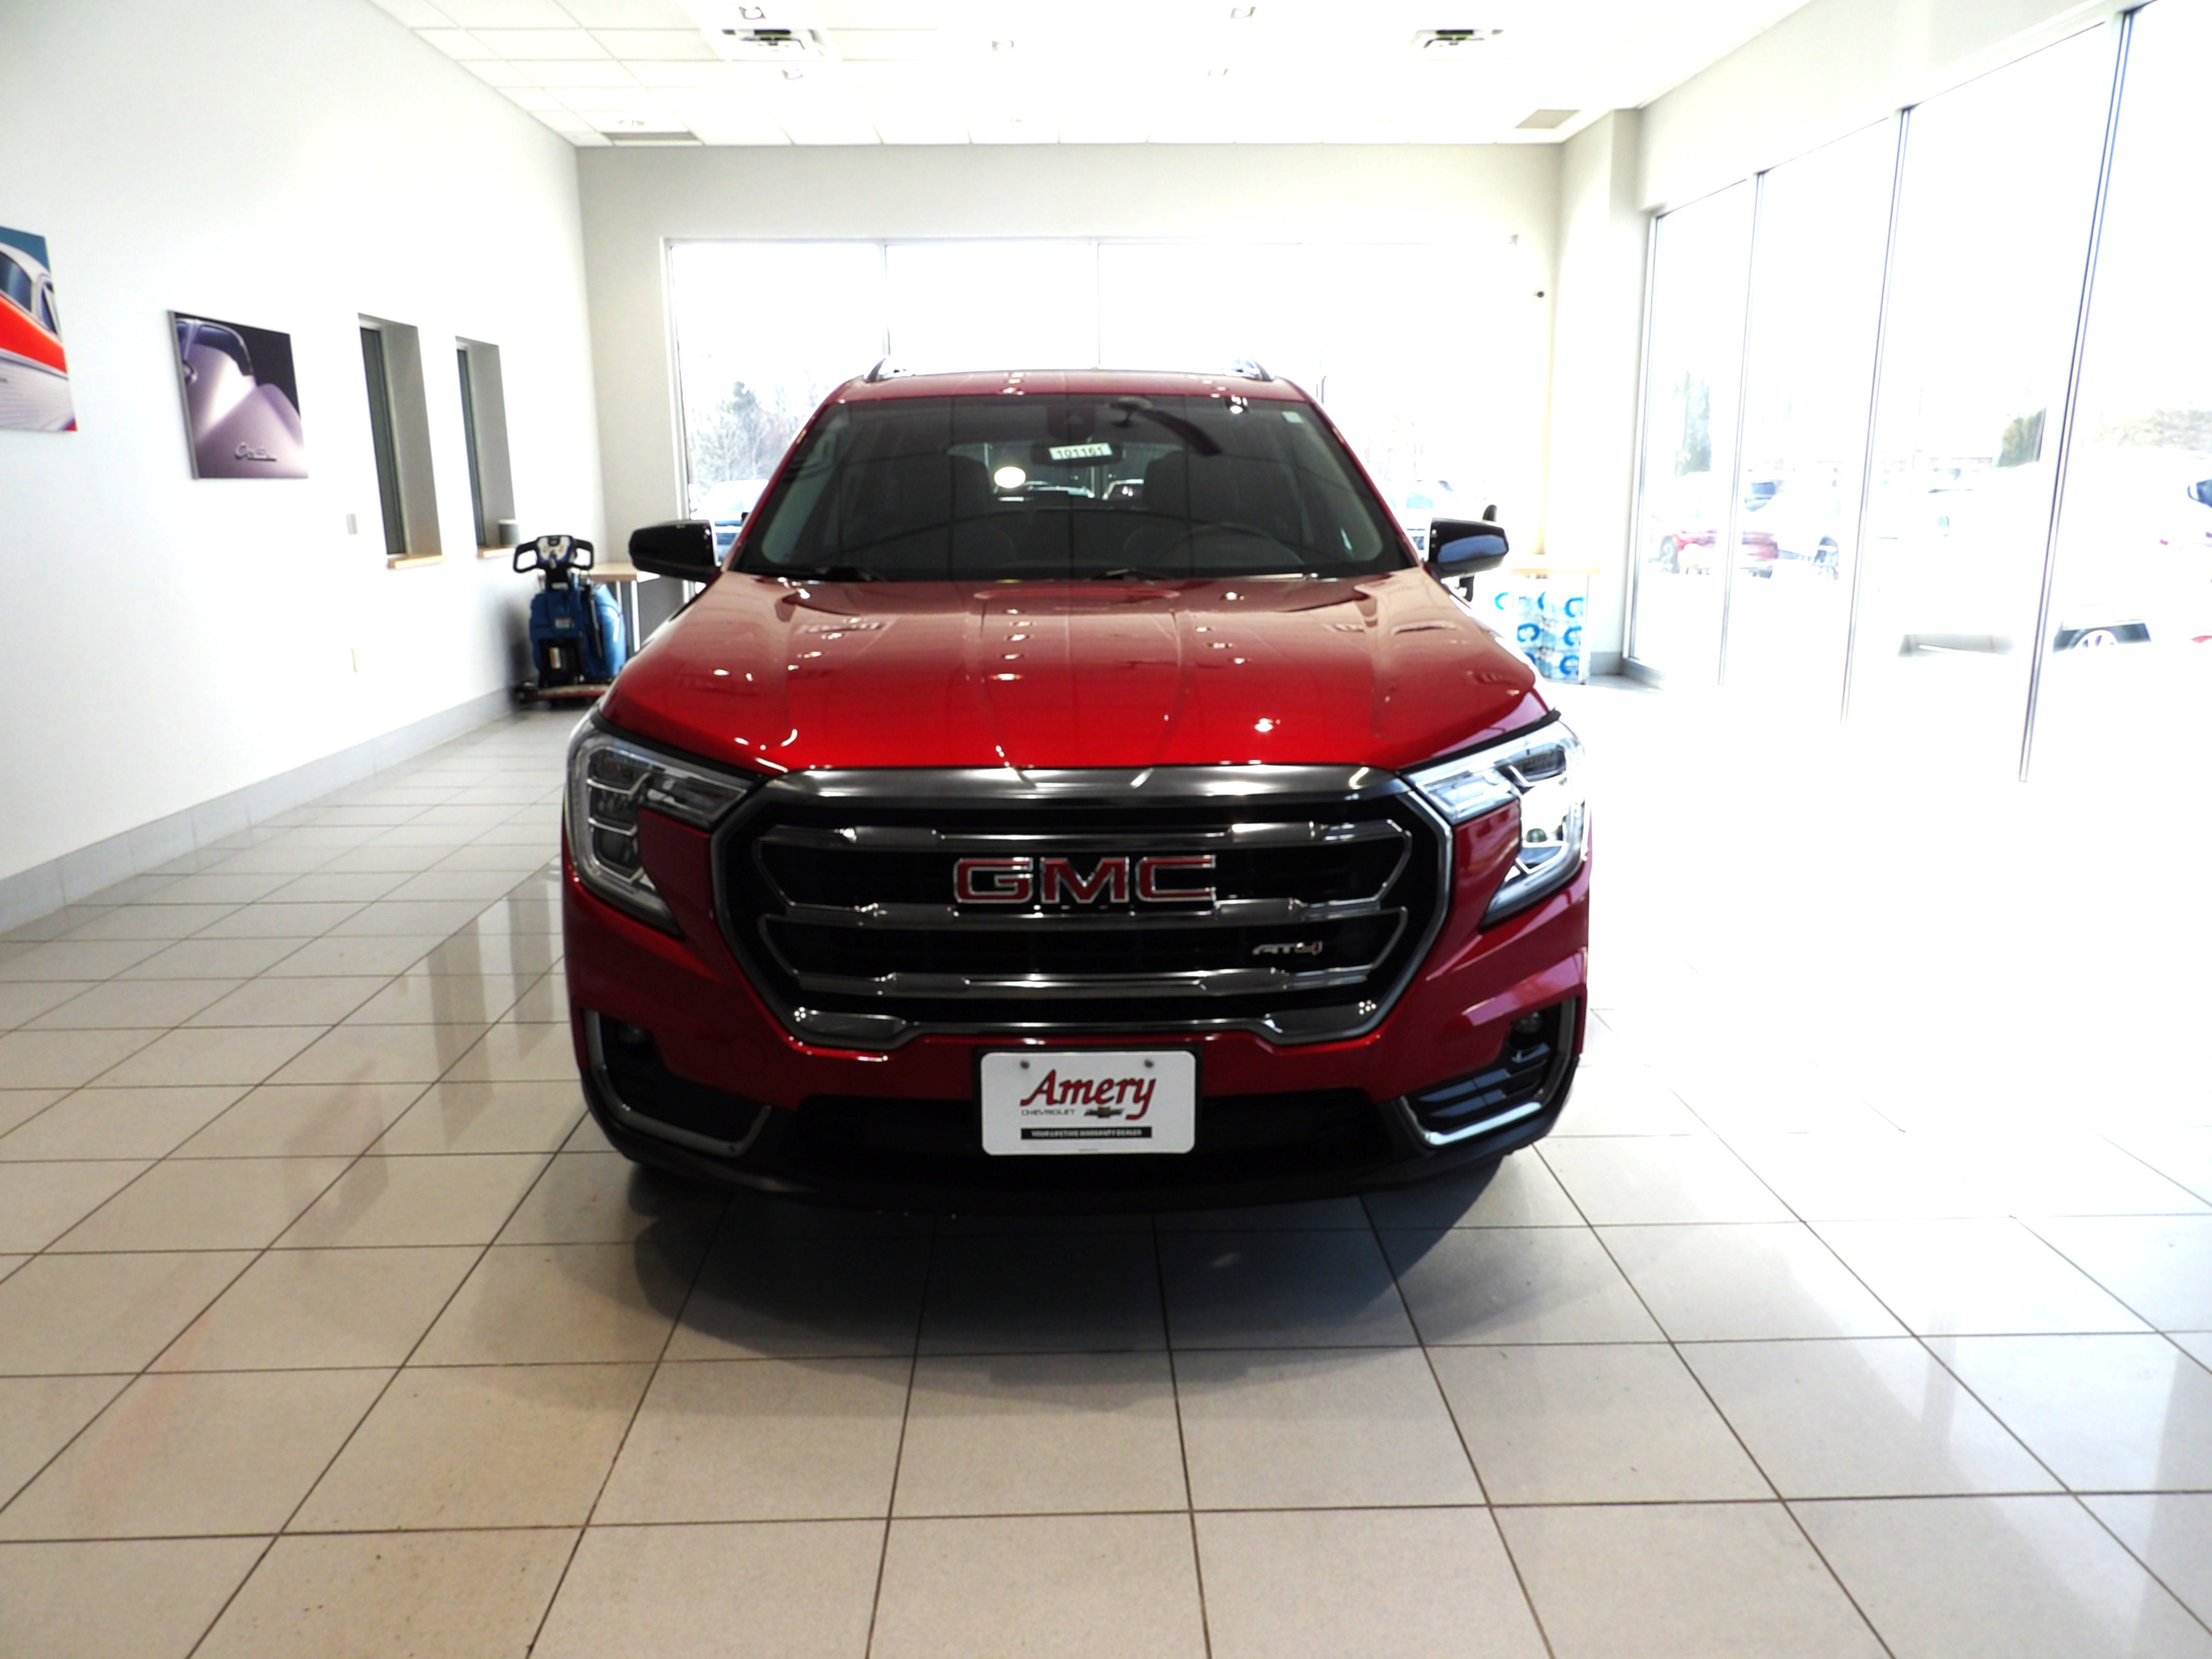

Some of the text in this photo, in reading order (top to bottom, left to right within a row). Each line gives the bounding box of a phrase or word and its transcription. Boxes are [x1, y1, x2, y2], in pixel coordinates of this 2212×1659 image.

[953, 854, 1216, 903] GMC
[1252, 940, 1323, 956] AT4
[1020, 1069, 1156, 1120] Amery
